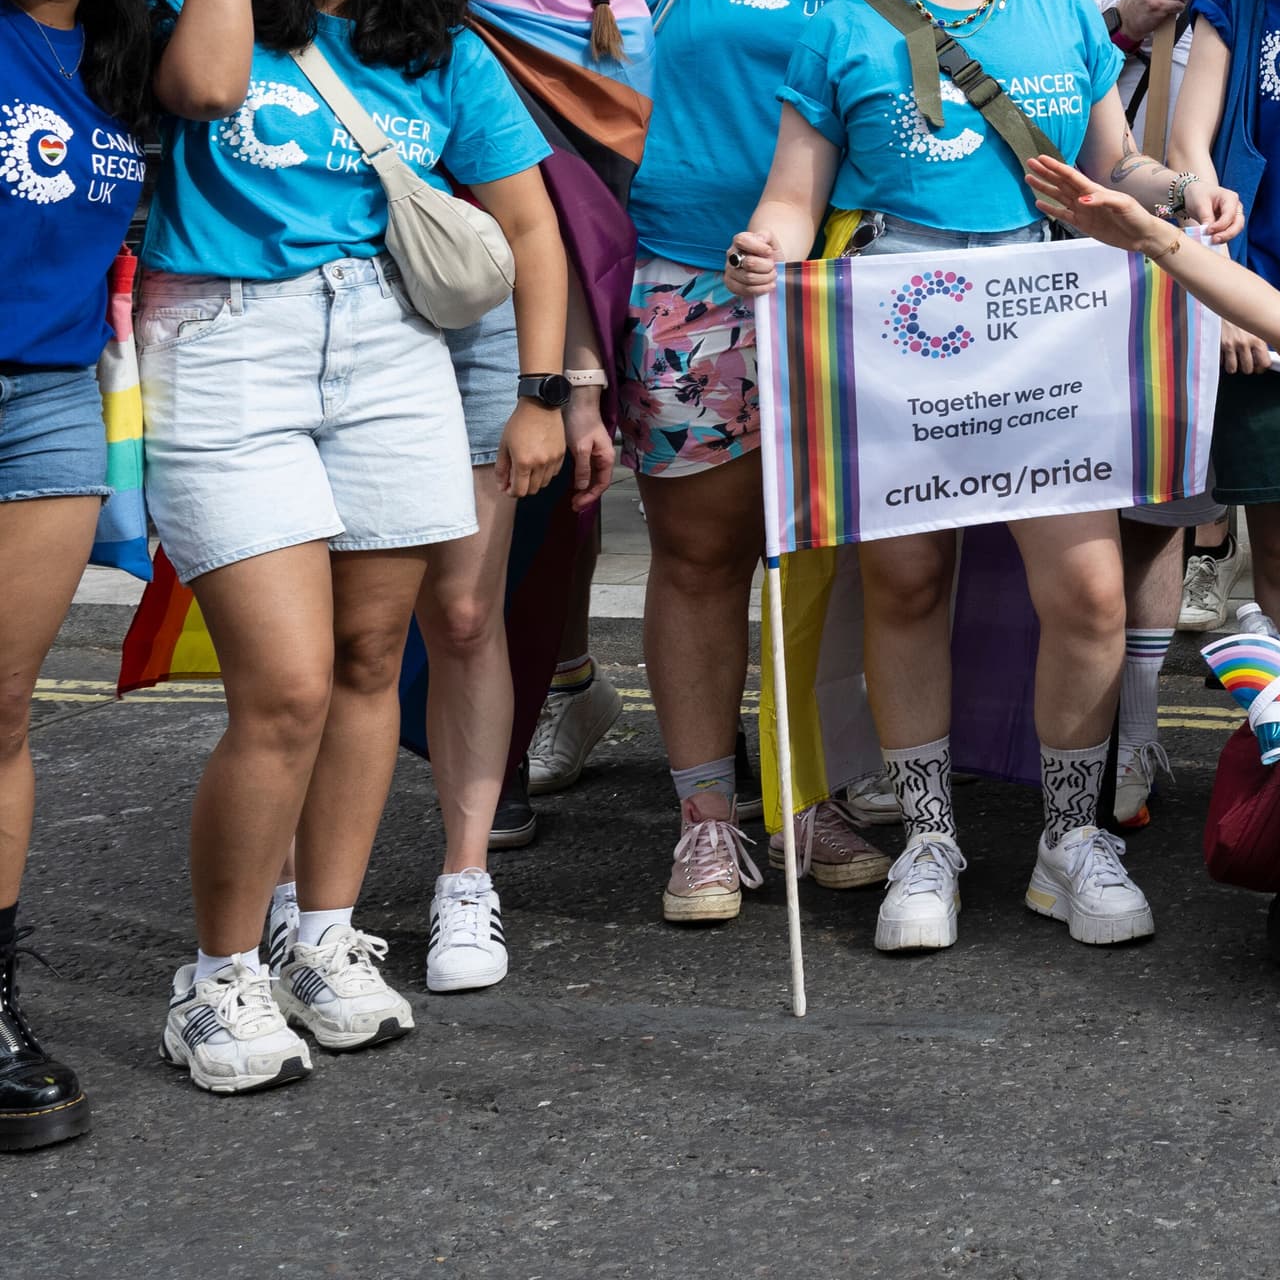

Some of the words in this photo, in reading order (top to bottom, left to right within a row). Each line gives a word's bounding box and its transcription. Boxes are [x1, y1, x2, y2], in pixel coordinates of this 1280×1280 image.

[1012, 95, 1083, 118] SEARC
[335, 111, 431, 143] NCER
[91, 153, 147, 183] RESEAR
[326, 151, 362, 174] UK
[87, 179, 117, 205] UK
[985, 272, 1079, 297] CANCER
[986, 290, 1108, 319] RESEARCH
[987, 321, 1019, 341] UK
[907, 391, 1011, 417] Together
[1014, 387, 1045, 404] we
[1049, 380, 1083, 398] are
[912, 418, 1003, 442] beating
[1007, 404, 1079, 429] cancer
[885, 457, 1113, 507] cruk.org/pride
